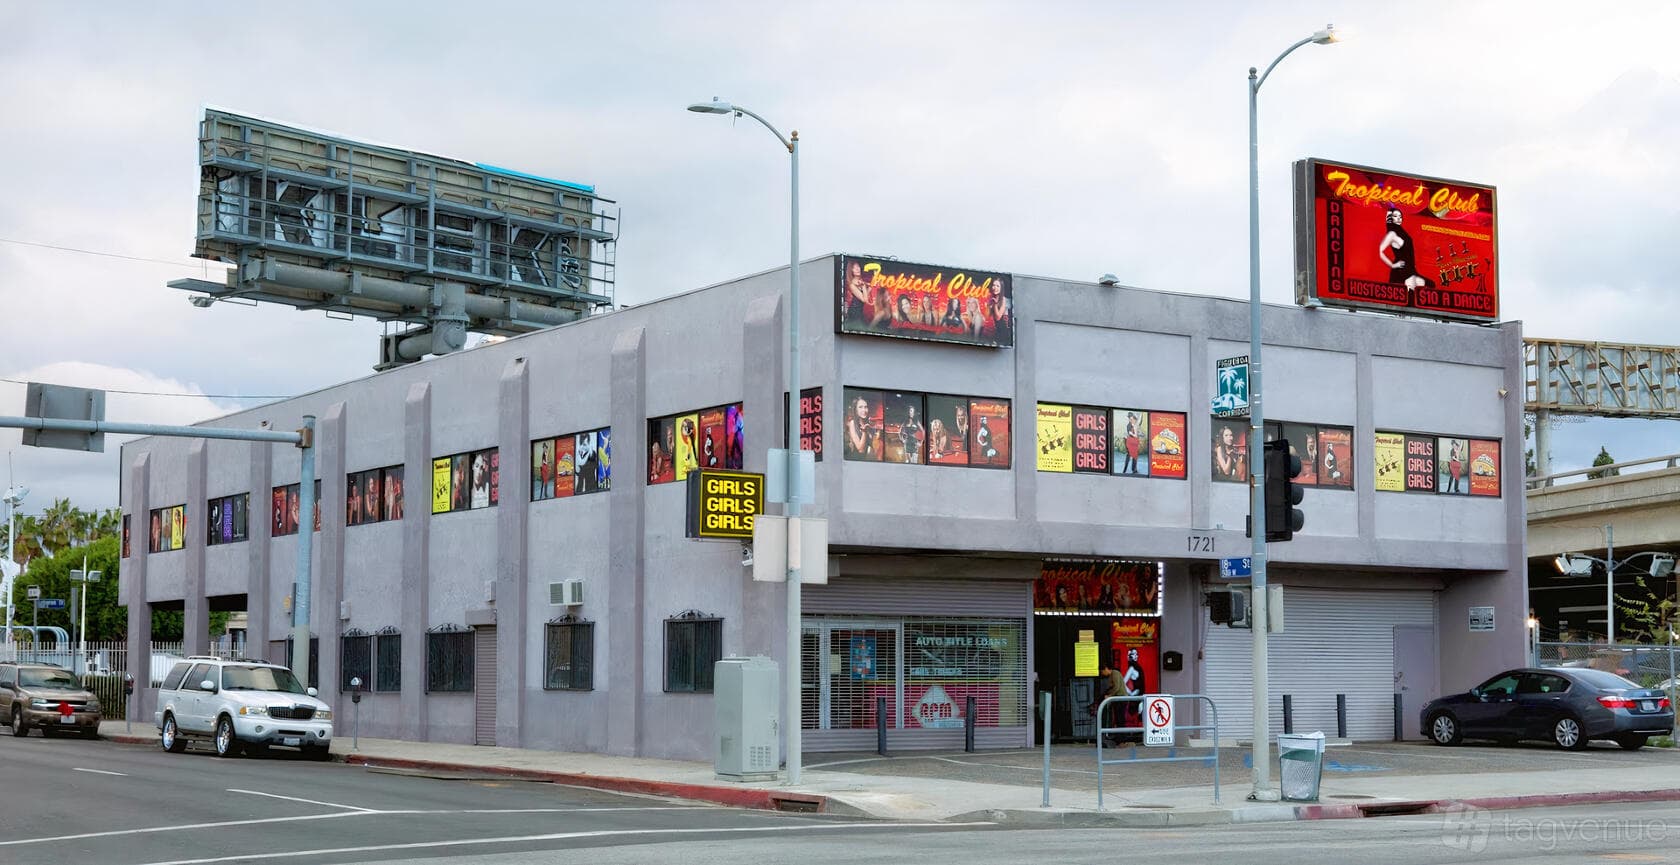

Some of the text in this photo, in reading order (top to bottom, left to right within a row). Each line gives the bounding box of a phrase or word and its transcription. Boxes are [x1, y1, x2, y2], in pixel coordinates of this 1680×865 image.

[1327, 170, 1480, 213] Tropical Club
[1330, 202, 1341, 291] DANCING
[863, 262, 992, 299] Tropical Club
[1350, 281, 1405, 301] HOSTESSES
[1419, 290, 1491, 310] $10 A DANCE
[1076, 413, 1106, 431] GIRLS
[1076, 433, 1106, 451] GIRLS
[1407, 440, 1433, 456] GIRLS
[1076, 451, 1106, 469] GIRLS
[1407, 457, 1433, 473] GIRLS
[707, 479, 756, 496] GIRLS
[1407, 473, 1433, 489] GIRLS
[706, 496, 756, 514] GIRLS
[706, 513, 754, 530] GIRLS
[1187, 536, 1215, 553] 1721
[1041, 564, 1096, 581] ropical
[916, 636, 943, 646] AUTO
[975, 636, 1008, 647] LOANS
